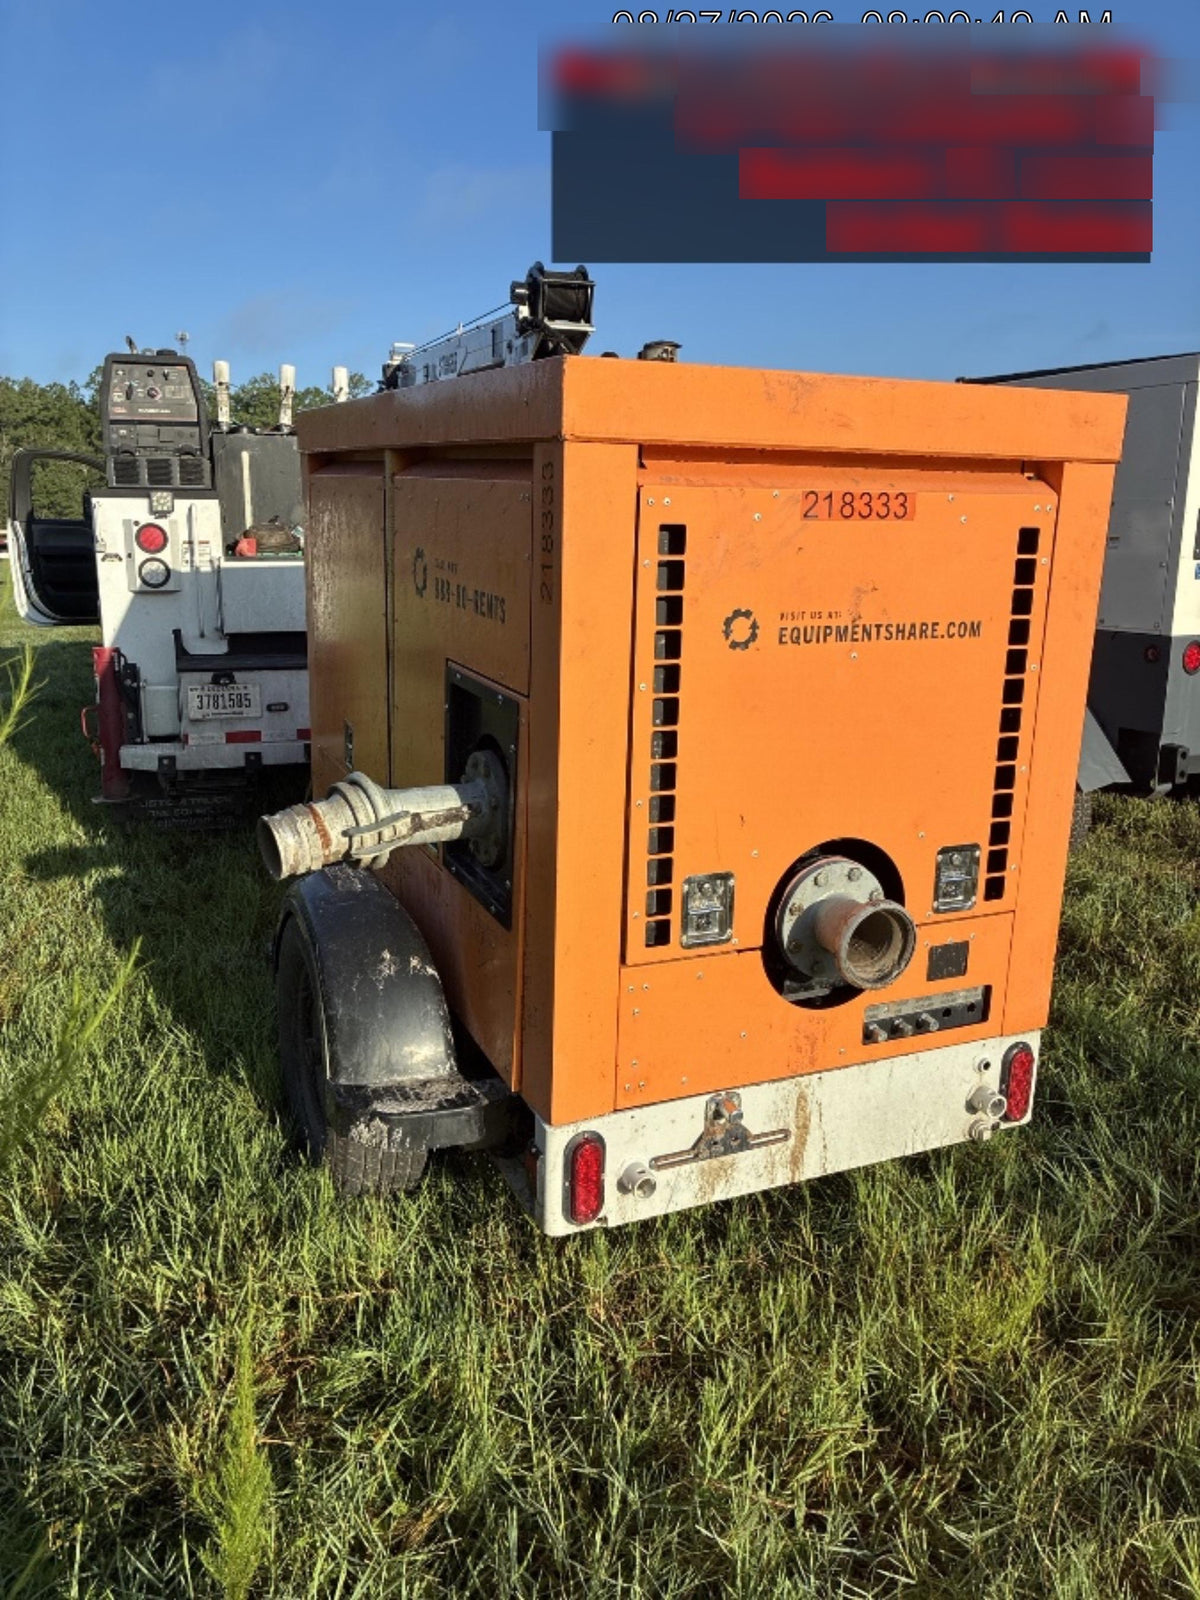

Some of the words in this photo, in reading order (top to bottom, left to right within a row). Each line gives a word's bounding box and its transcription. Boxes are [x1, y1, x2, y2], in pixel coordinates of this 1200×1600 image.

[803, 490, 908, 519] 218333
[541, 461, 554, 604] 218333
[779, 611, 806, 621] VISIT
[810, 611, 823, 620] US
[778, 621, 982, 645] EQUIPMENTSHARE.COM
